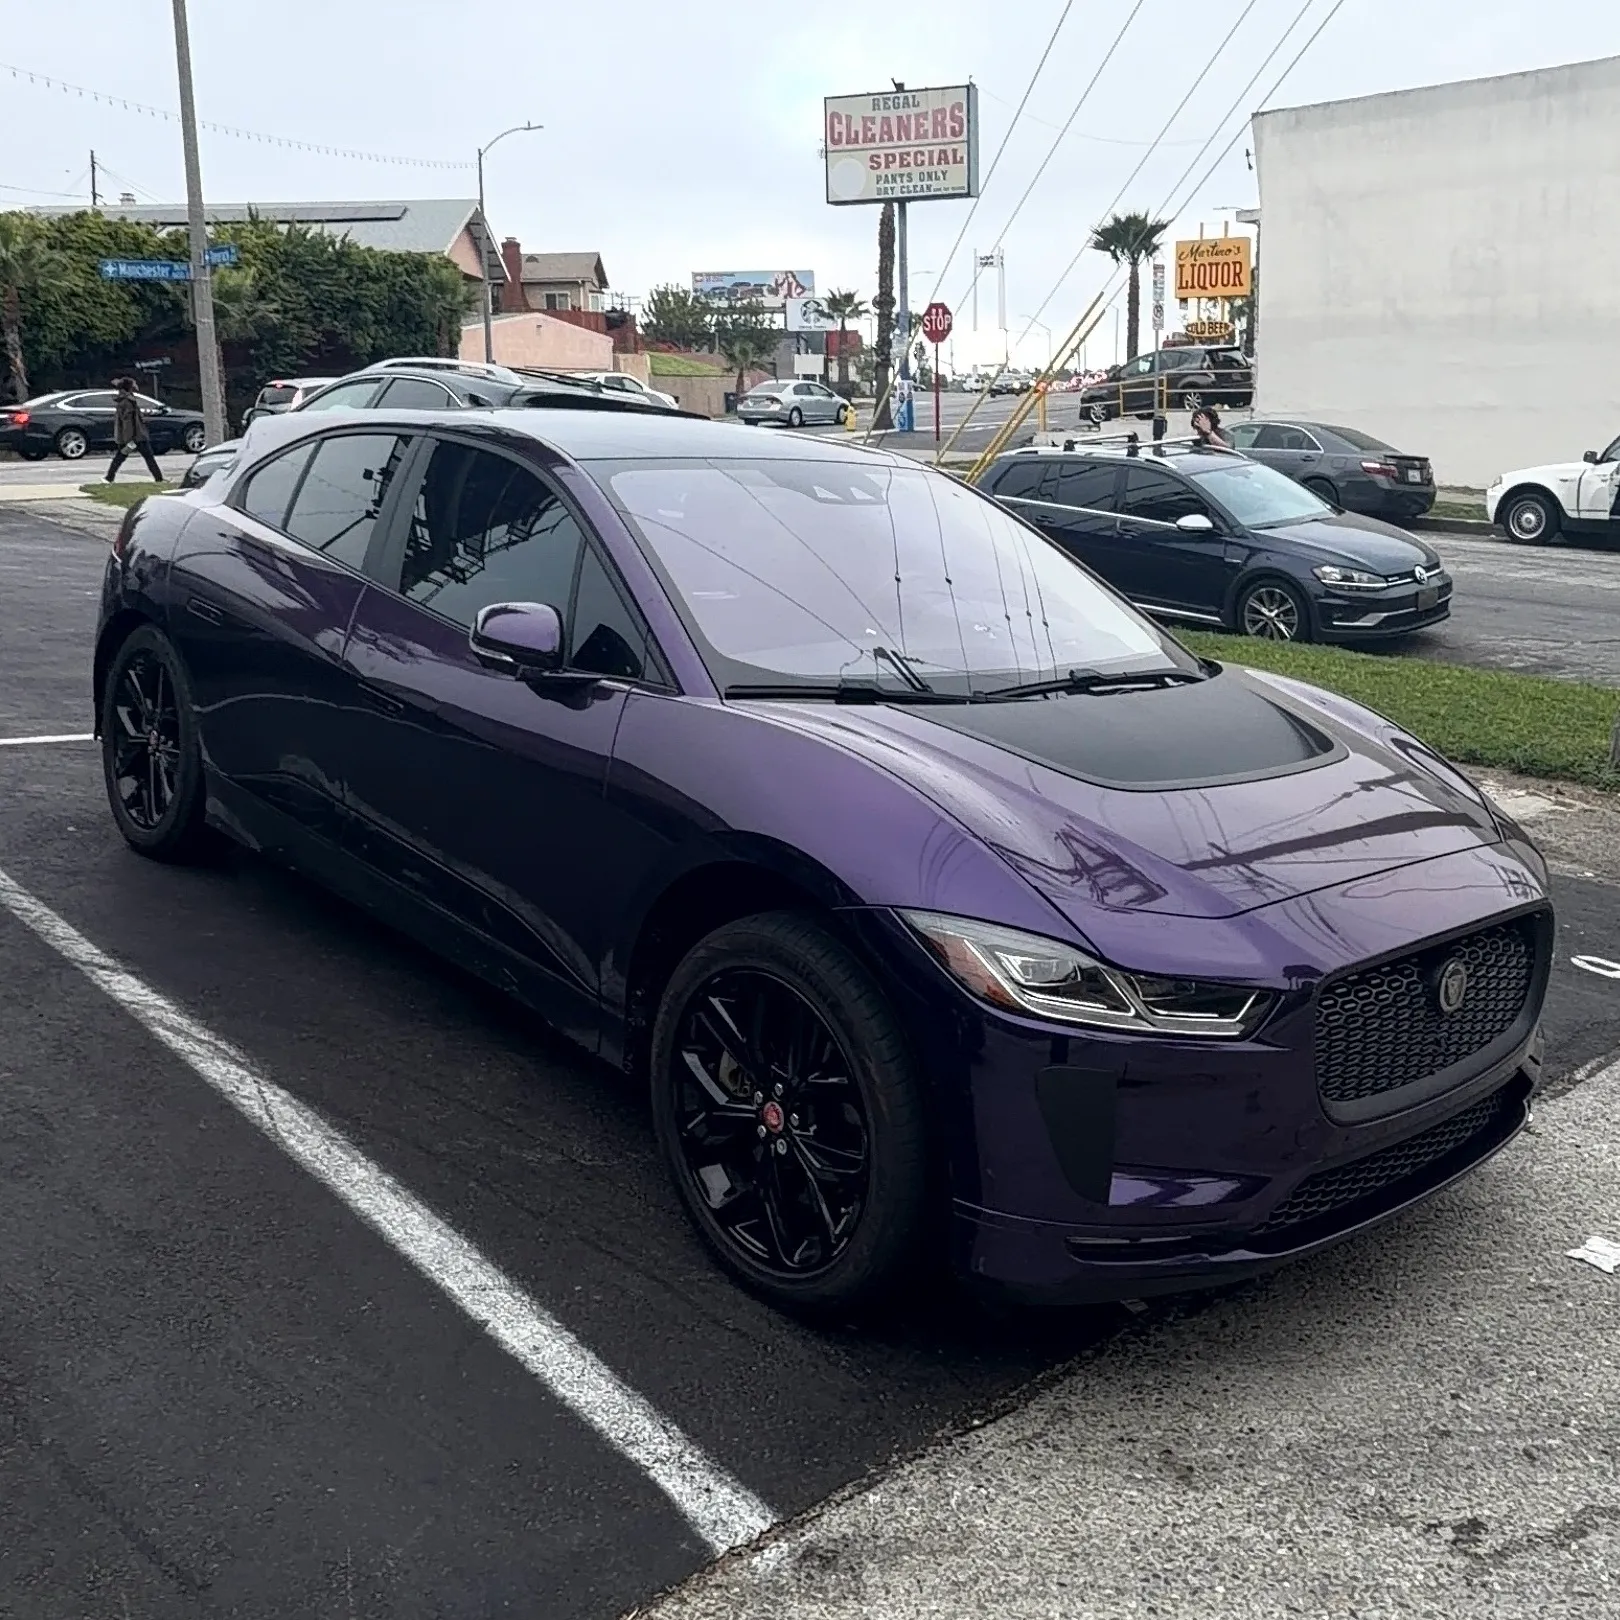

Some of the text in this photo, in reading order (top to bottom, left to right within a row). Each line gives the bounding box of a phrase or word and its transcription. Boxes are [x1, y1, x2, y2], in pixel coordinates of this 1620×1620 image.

[872, 94, 920, 111] REGAL
[829, 102, 964, 145] CLEANERS
[869, 148, 964, 170] SPECIAL
[876, 170, 948, 185] PANTS ONLY
[876, 186, 896, 196] DRY
[900, 184, 933, 194] CLEAN
[1178, 261, 1244, 290] LIQUOR
[923, 312, 951, 331] STOP
